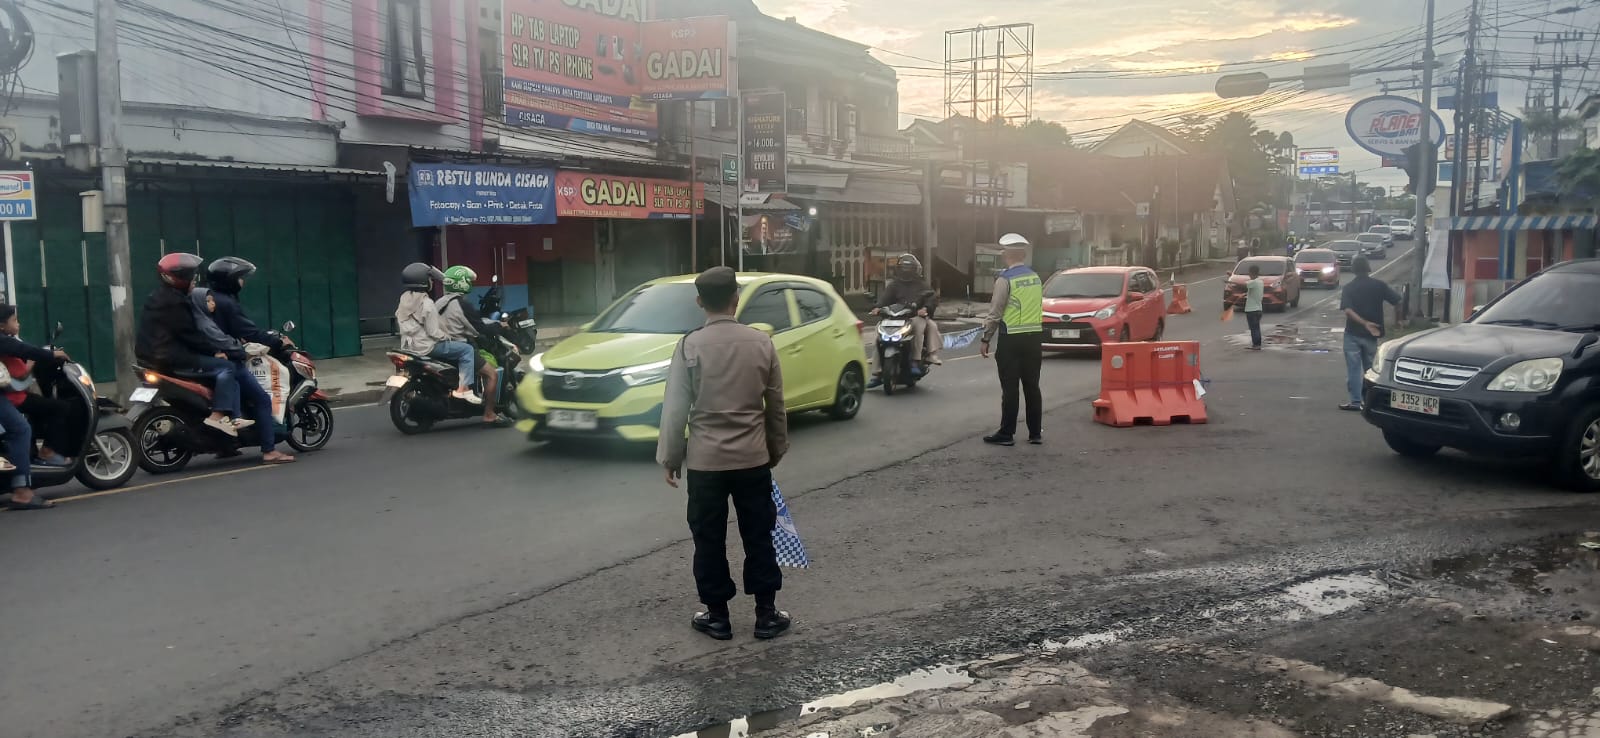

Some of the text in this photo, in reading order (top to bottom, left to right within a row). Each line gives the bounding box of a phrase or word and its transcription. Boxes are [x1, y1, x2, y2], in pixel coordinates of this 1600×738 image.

[511, 13, 581, 49] HP TAB LAPTOP
[671, 28, 689, 40] KSP
[512, 43, 529, 68] SLR
[533, 48, 545, 70] TV
[549, 50, 560, 74] PS
[646, 48, 722, 81] GADAI
[519, 111, 546, 124] CISAGA
[1369, 112, 1424, 132] PLANET
[1398, 127, 1419, 137] BAN
[1395, 138, 1409, 146] BAN
[437, 170, 549, 188] RESTU BUNDA CISAGA
[557, 185, 574, 197] KSP
[580, 177, 647, 208] GADAI
[653, 184, 662, 195] HP
[664, 185, 674, 197] TAB
[15, 203, 26, 216] M
[430, 200, 544, 211] Fotocopy Scan Print Cetak Foto
[654, 197, 665, 209] SLR
[667, 198, 674, 209] TV
[675, 199, 683, 209] PS
[1392, 392, 1397, 402] B
[1401, 393, 1420, 406] 1352
[1422, 397, 1438, 409] WCR
